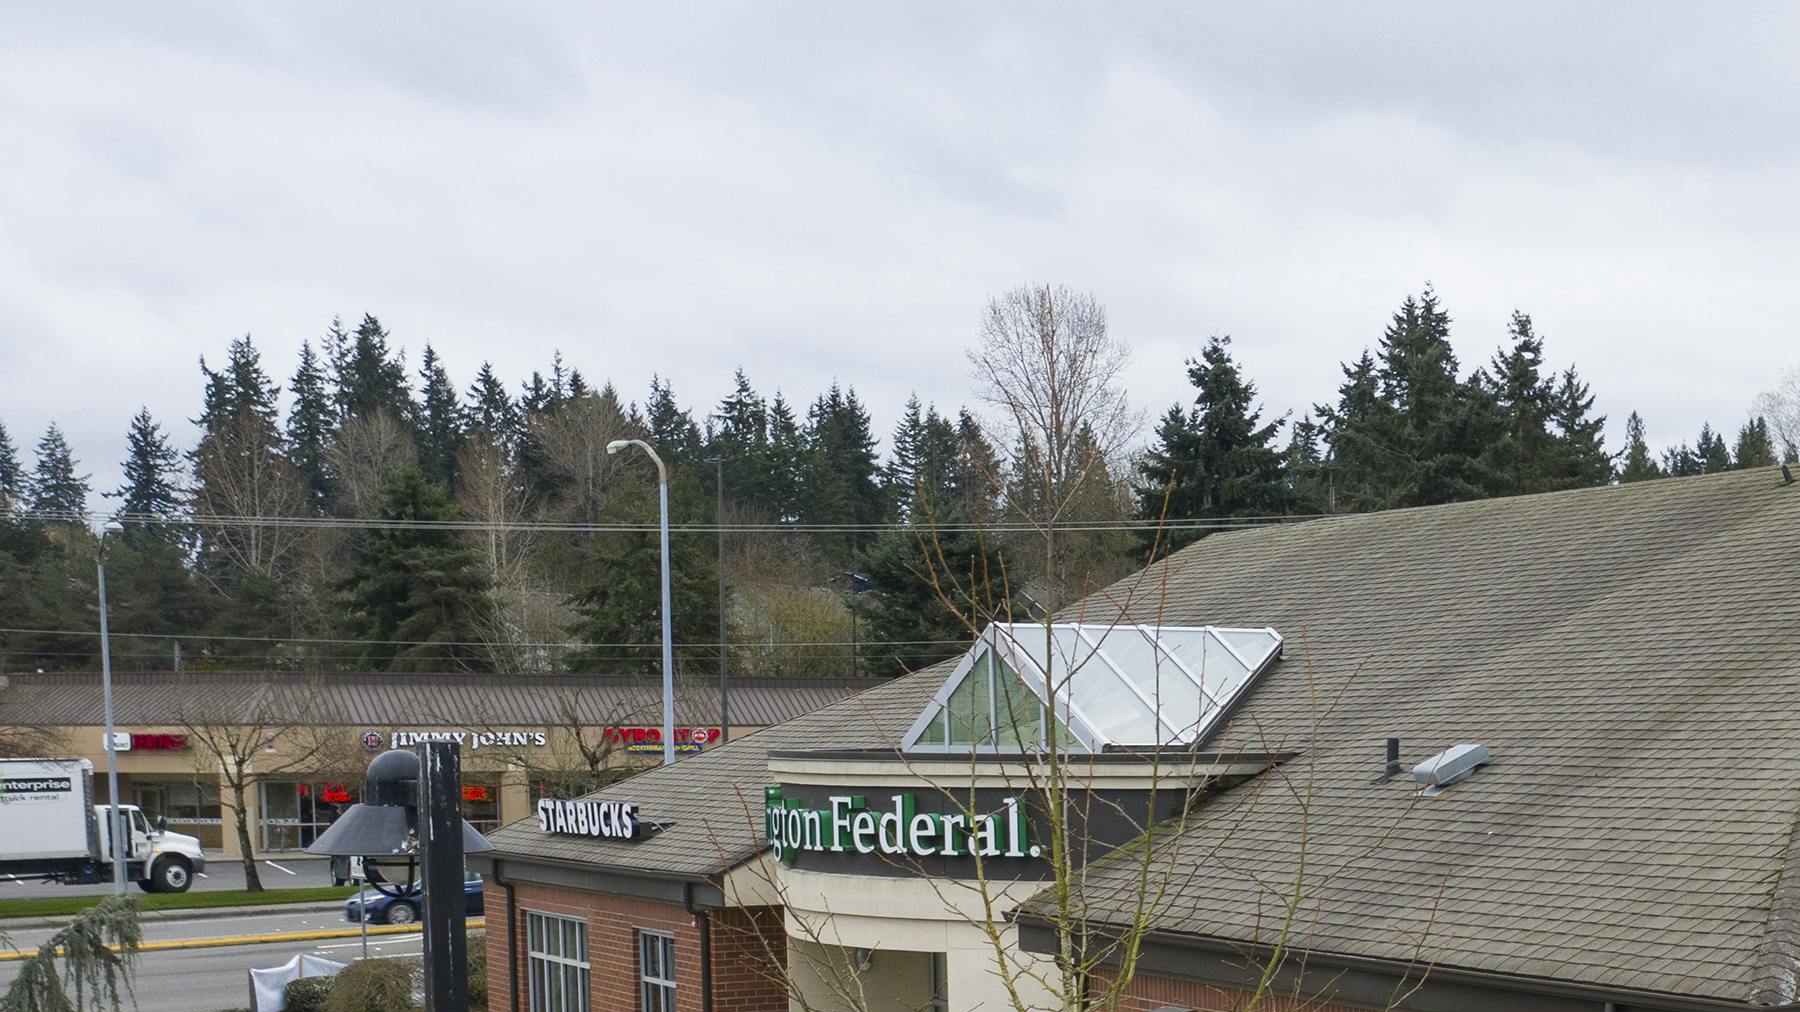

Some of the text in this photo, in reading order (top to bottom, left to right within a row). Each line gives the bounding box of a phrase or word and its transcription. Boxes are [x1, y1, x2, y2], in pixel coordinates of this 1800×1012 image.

[390, 732, 466, 749] JIMMY
[471, 732, 546, 749] JOHN'S
[538, 799, 633, 839] STARBUCKS
